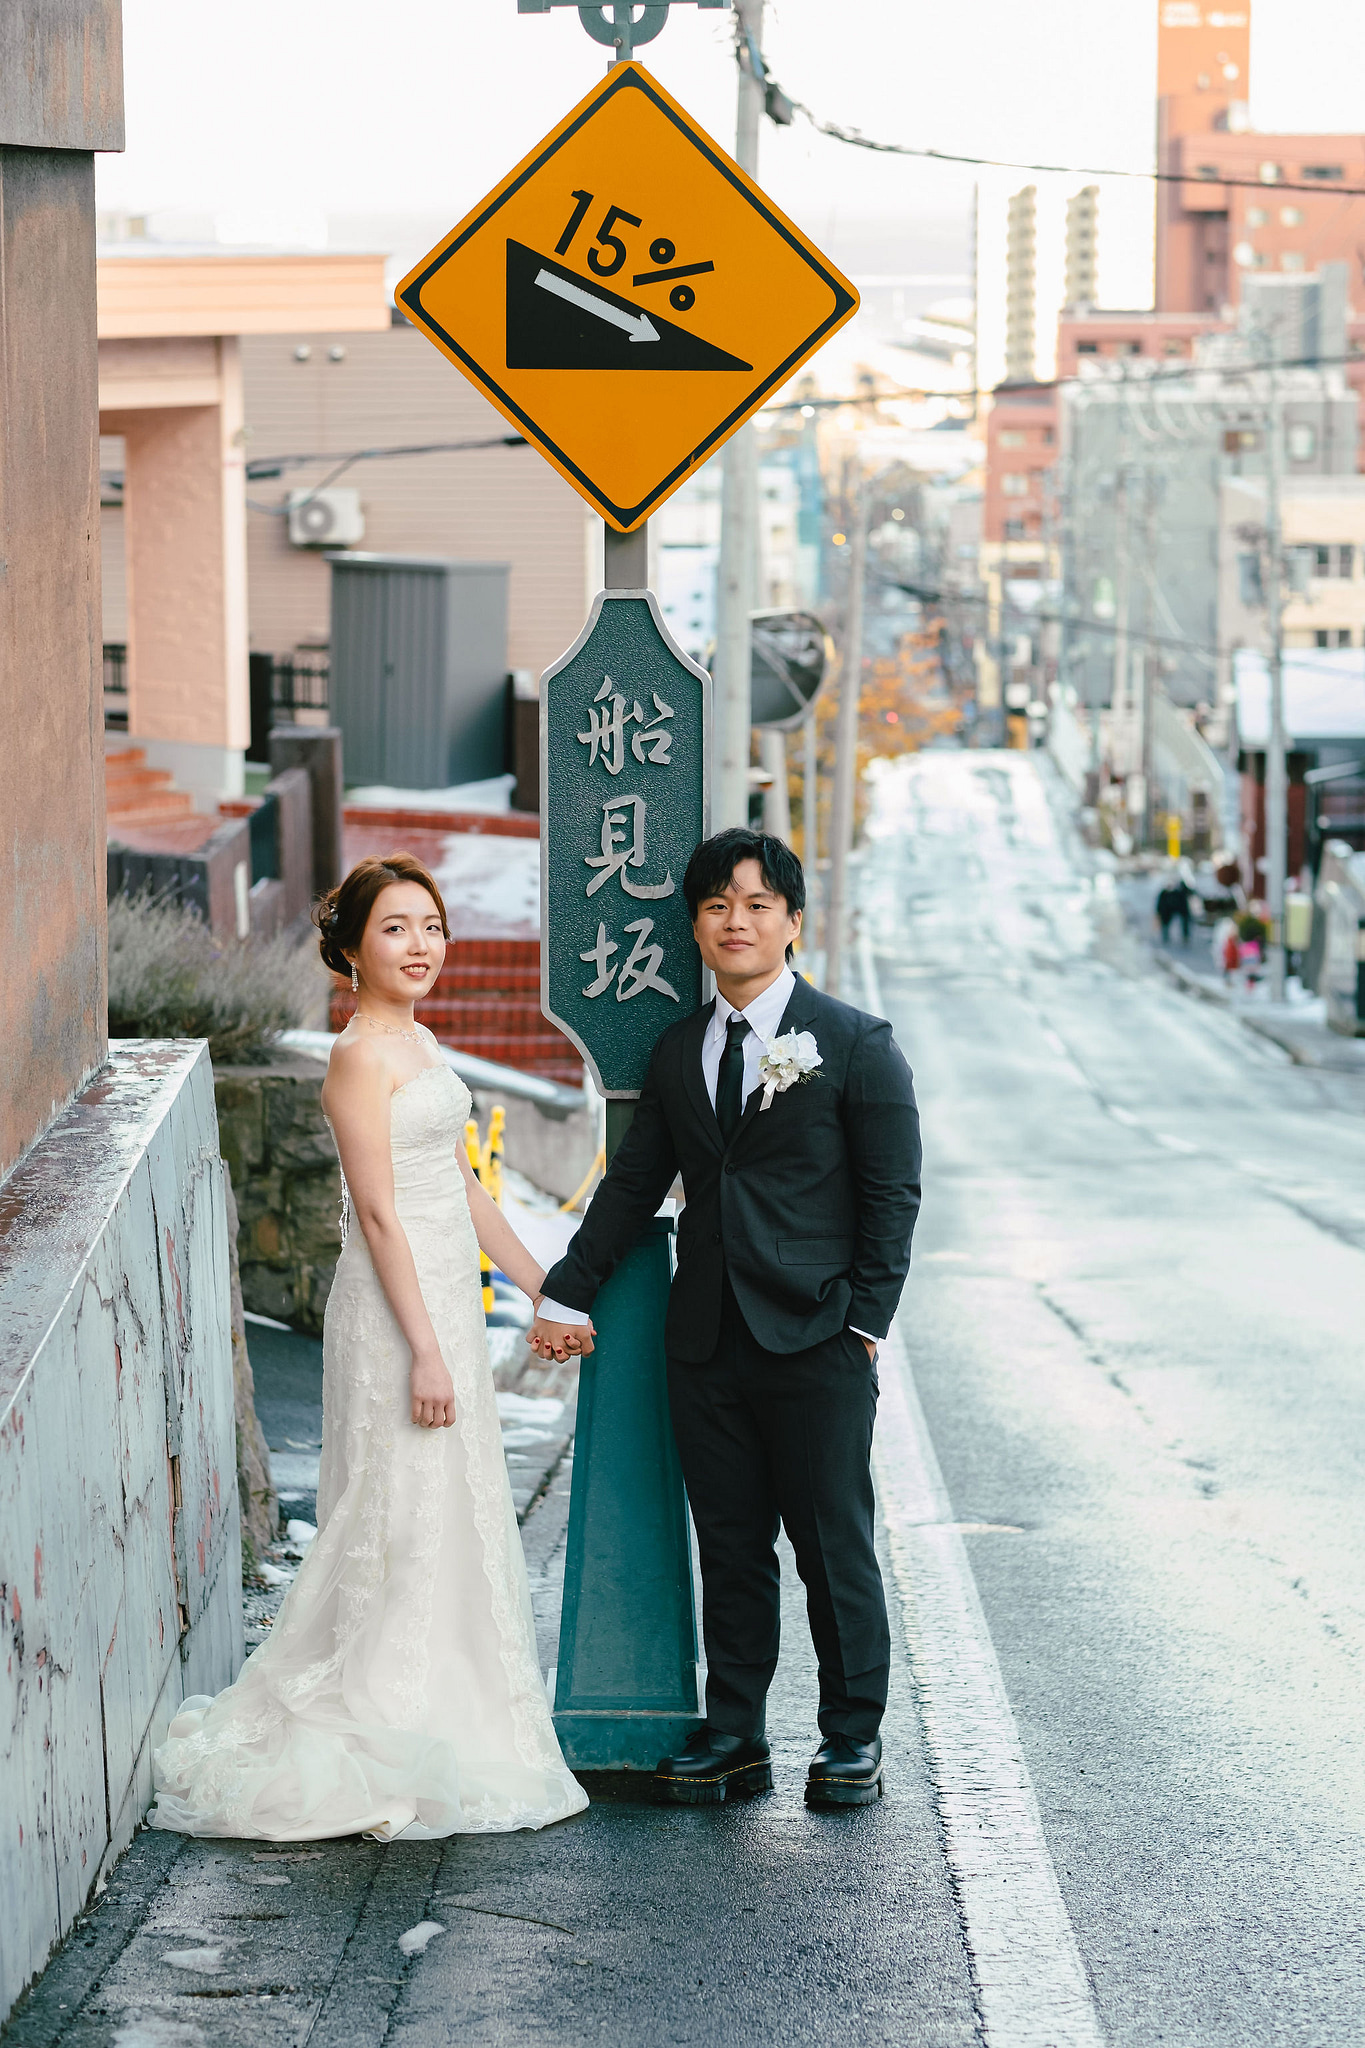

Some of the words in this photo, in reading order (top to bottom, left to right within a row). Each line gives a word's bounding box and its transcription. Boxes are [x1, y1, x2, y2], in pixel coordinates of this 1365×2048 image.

[554, 189, 715, 312] 15%
[577, 674, 681, 1004] 船見坂
